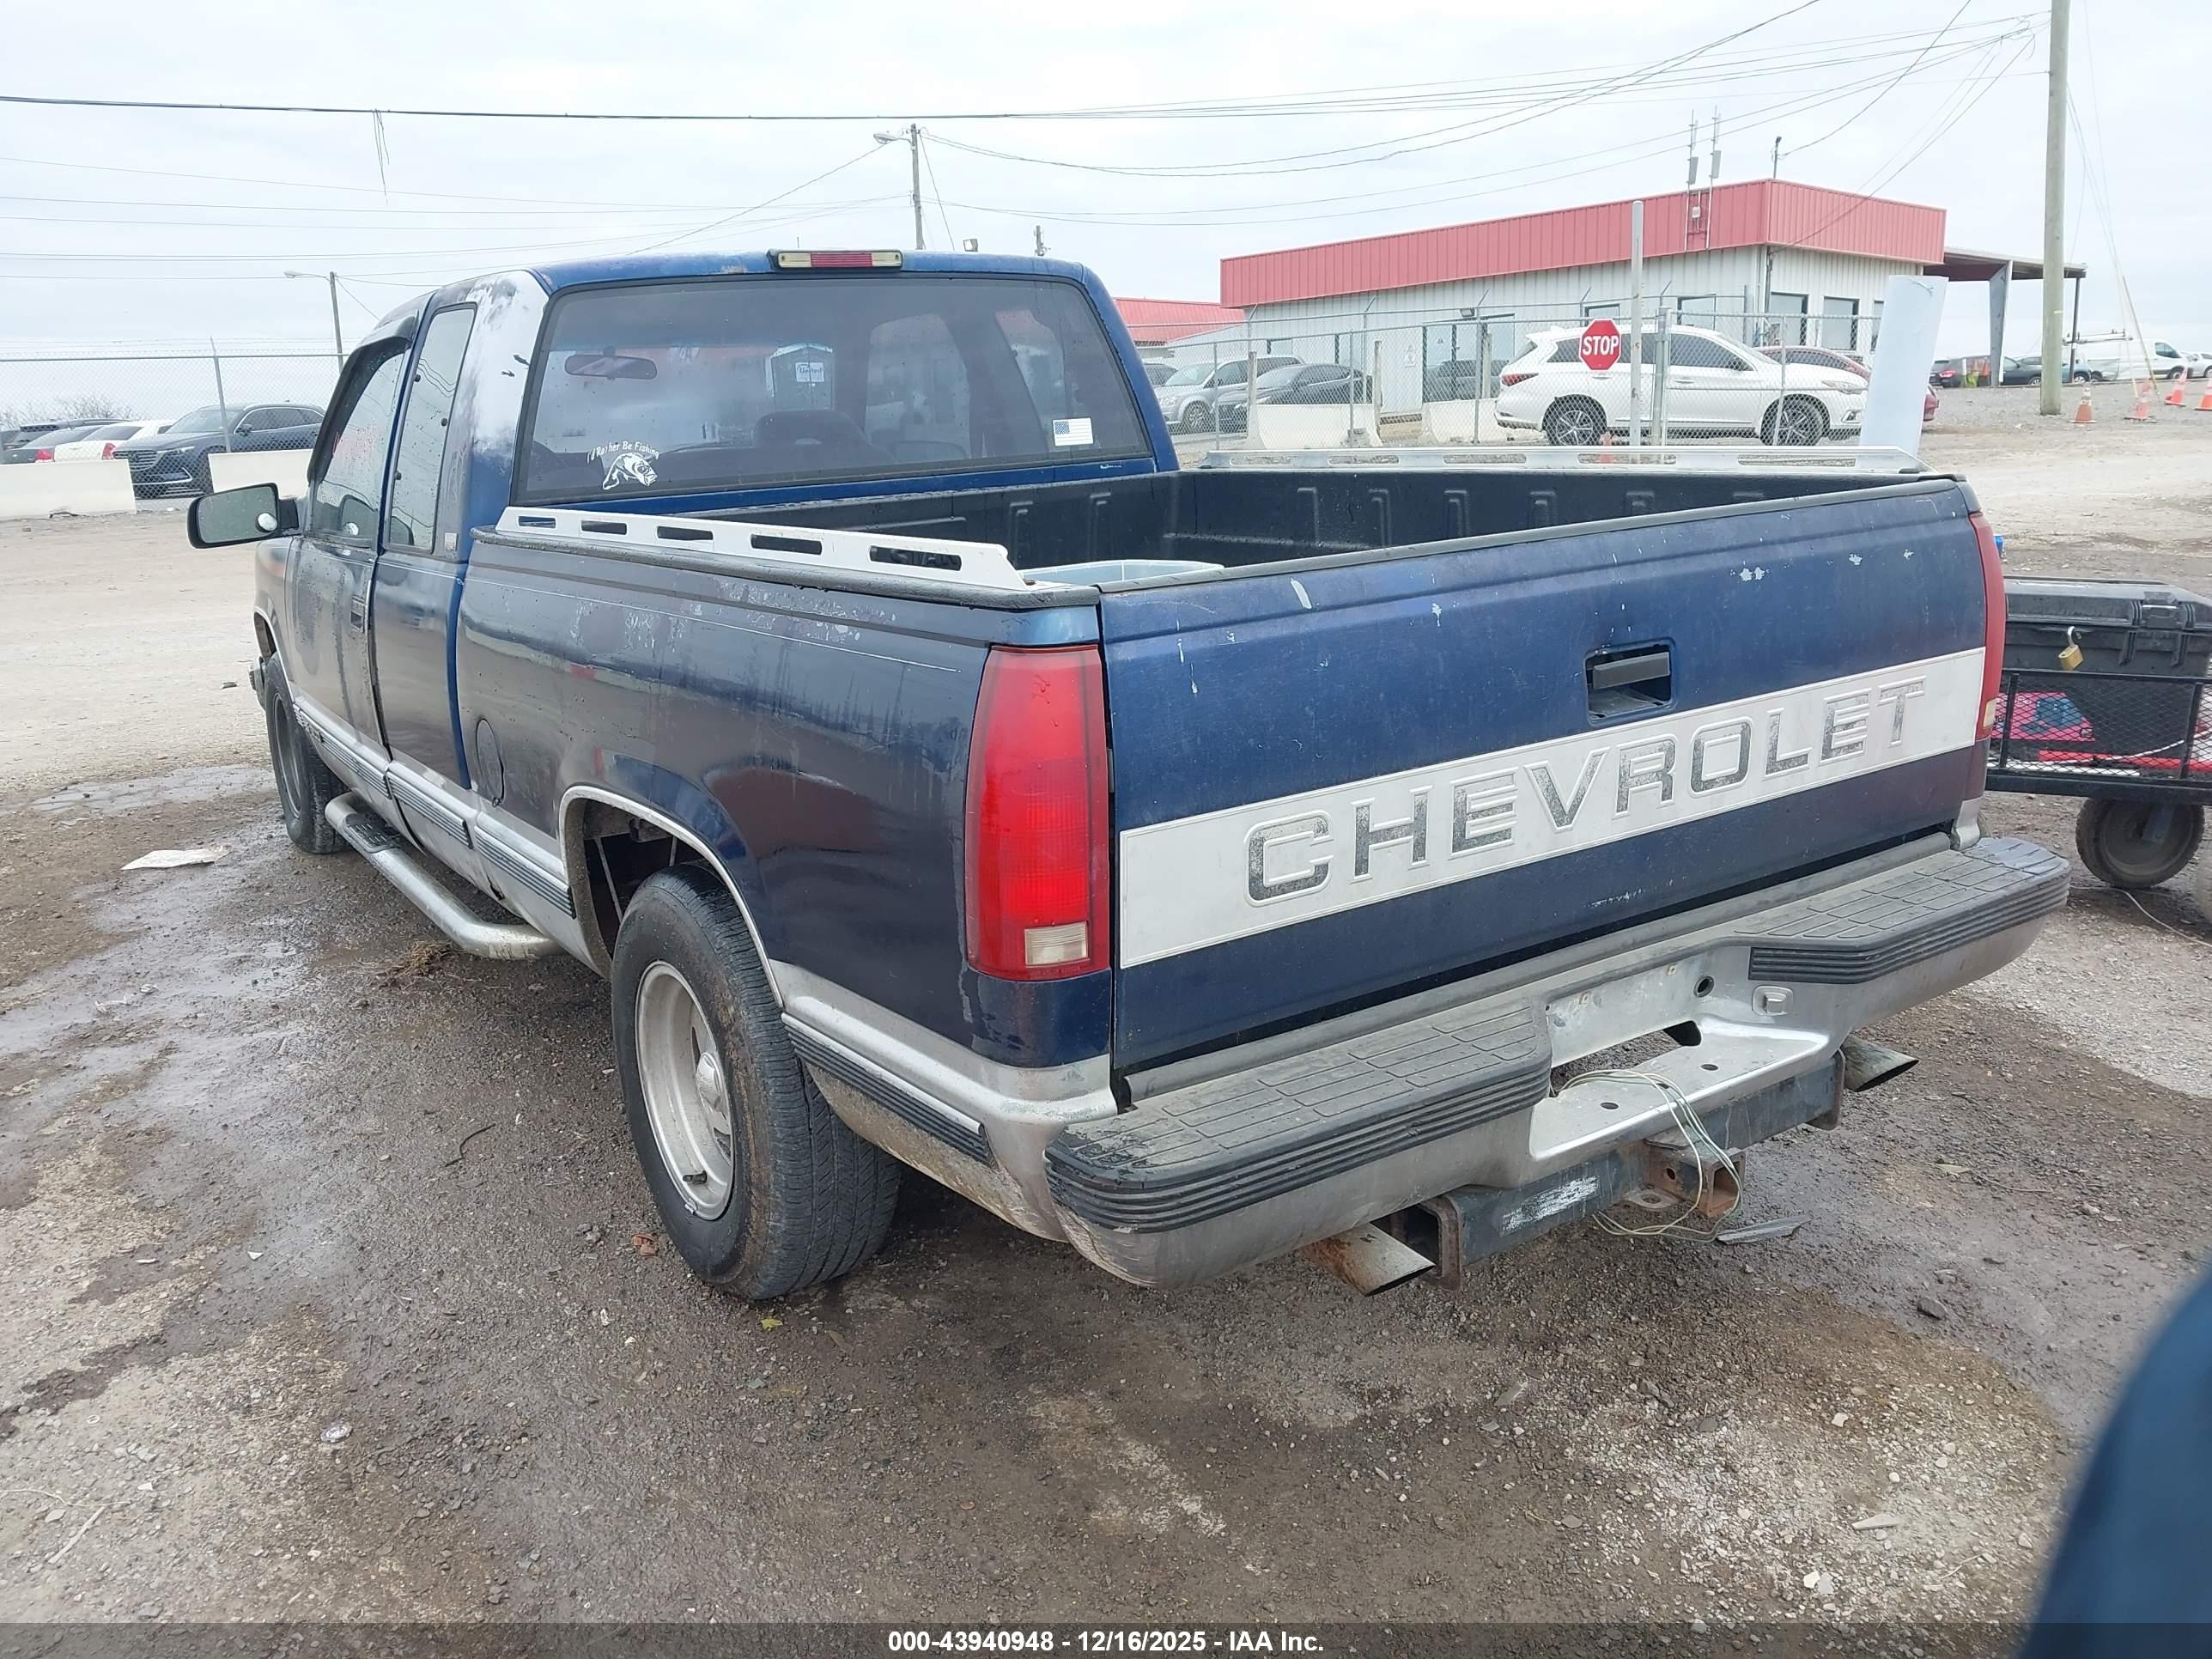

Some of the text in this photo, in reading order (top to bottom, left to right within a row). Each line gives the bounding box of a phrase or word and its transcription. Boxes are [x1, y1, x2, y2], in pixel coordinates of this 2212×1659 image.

[1582, 335, 1620, 356] STOP
[622, 440, 632, 450] Be
[634, 441, 659, 460] Fishing
[1245, 674, 1926, 908] CHEVROLET
